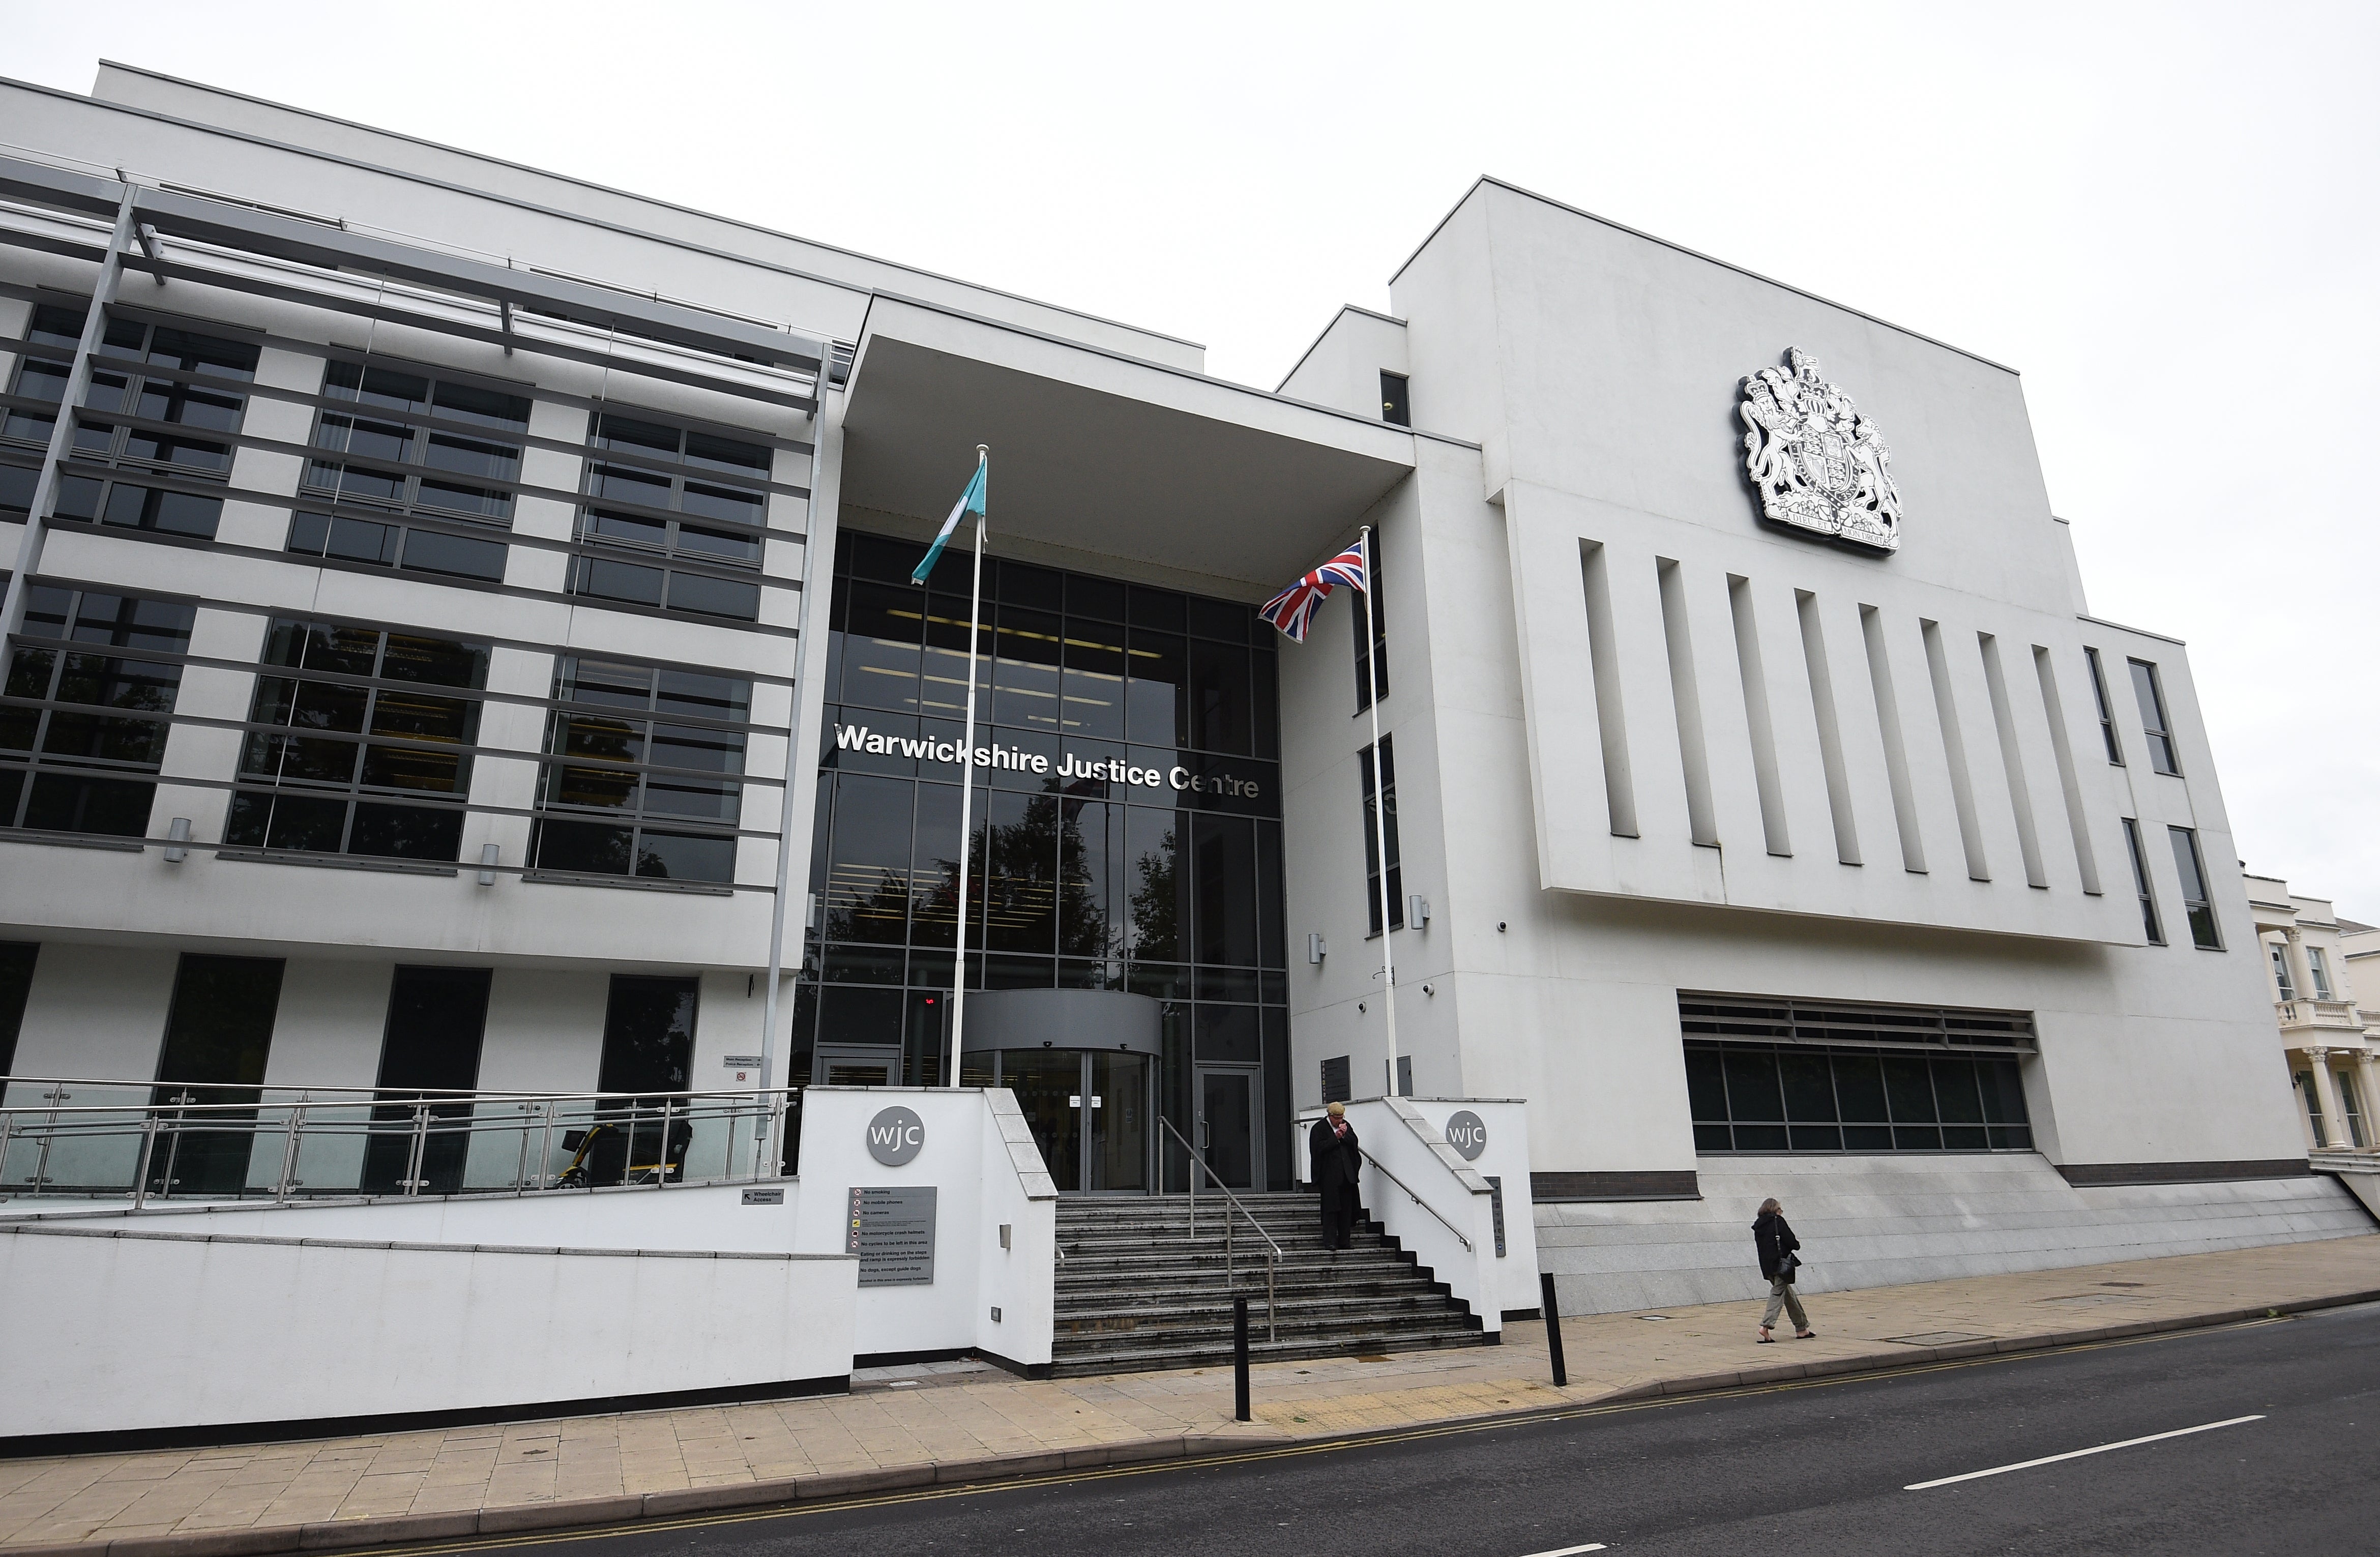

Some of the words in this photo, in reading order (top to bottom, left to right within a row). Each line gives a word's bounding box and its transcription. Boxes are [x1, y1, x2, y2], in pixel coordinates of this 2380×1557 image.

[1793, 514, 1813, 525] DIEU
[1844, 528, 1860, 538] MON
[1862, 532, 1883, 544] DROIT
[835, 723, 1048, 774] Warwickshire
[1056, 753, 1161, 787] Justice
[1169, 766, 1259, 798] Centre
[871, 1120, 919, 1152] wjc
[1449, 1122, 1483, 1149] wjc
